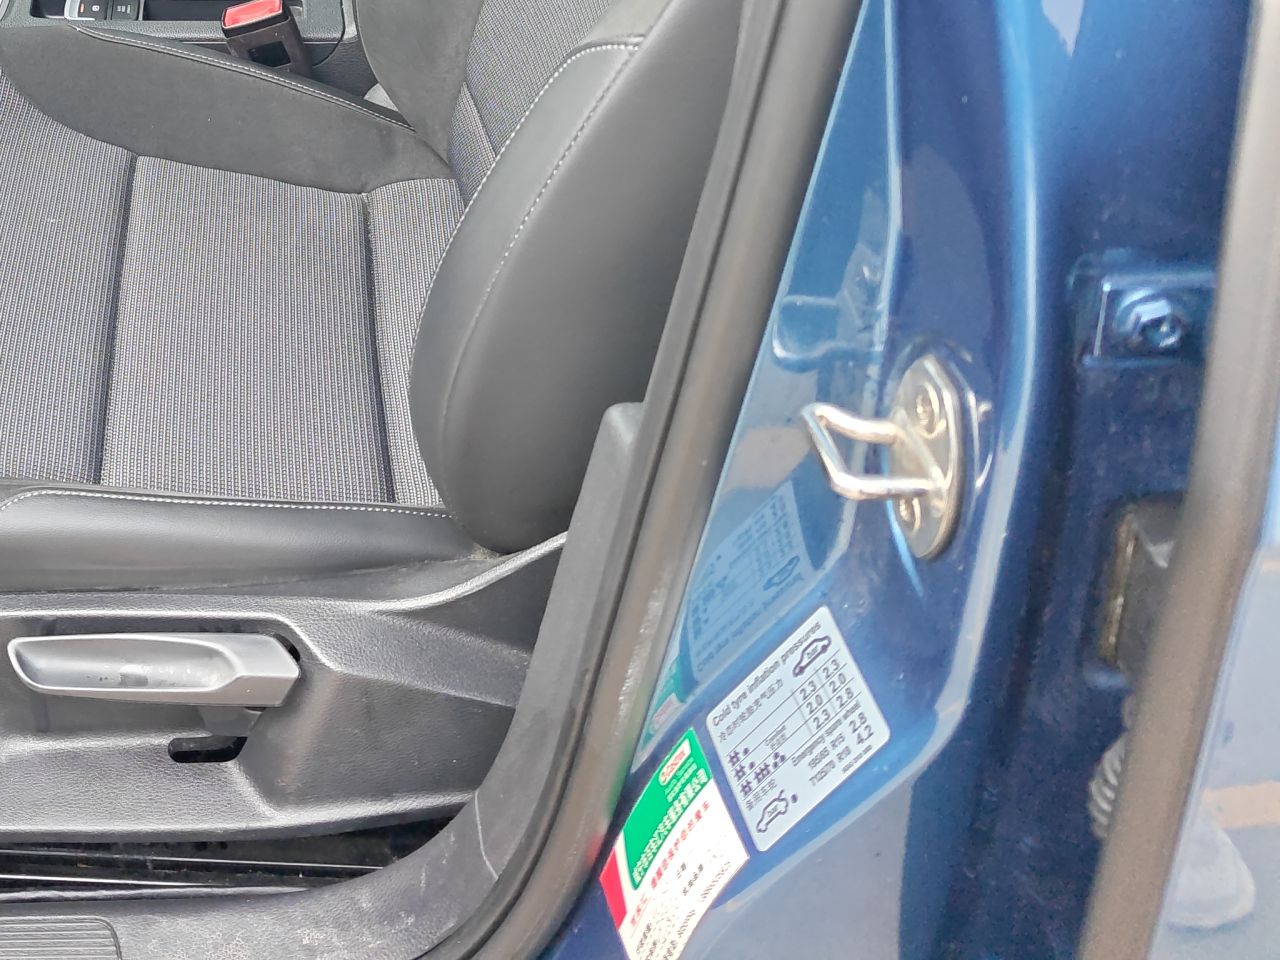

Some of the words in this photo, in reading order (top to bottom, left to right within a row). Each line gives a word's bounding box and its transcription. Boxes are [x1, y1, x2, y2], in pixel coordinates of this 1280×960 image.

[805, 644, 819, 659] bar
[711, 704, 732, 728] Cold
[730, 689, 748, 711] tyre
[746, 658, 780, 694] inflation
[779, 621, 822, 664] pressures
[798, 679, 817, 701] 2.3
[821, 657, 840, 679] 2.3
[805, 692, 824, 715] 2.0
[828, 671, 847, 693] 2.0
[812, 707, 831, 730] 2.3
[835, 685, 854, 708] 2.8
[847, 711, 867, 734] 2.8
[853, 723, 874, 747] 4.2
